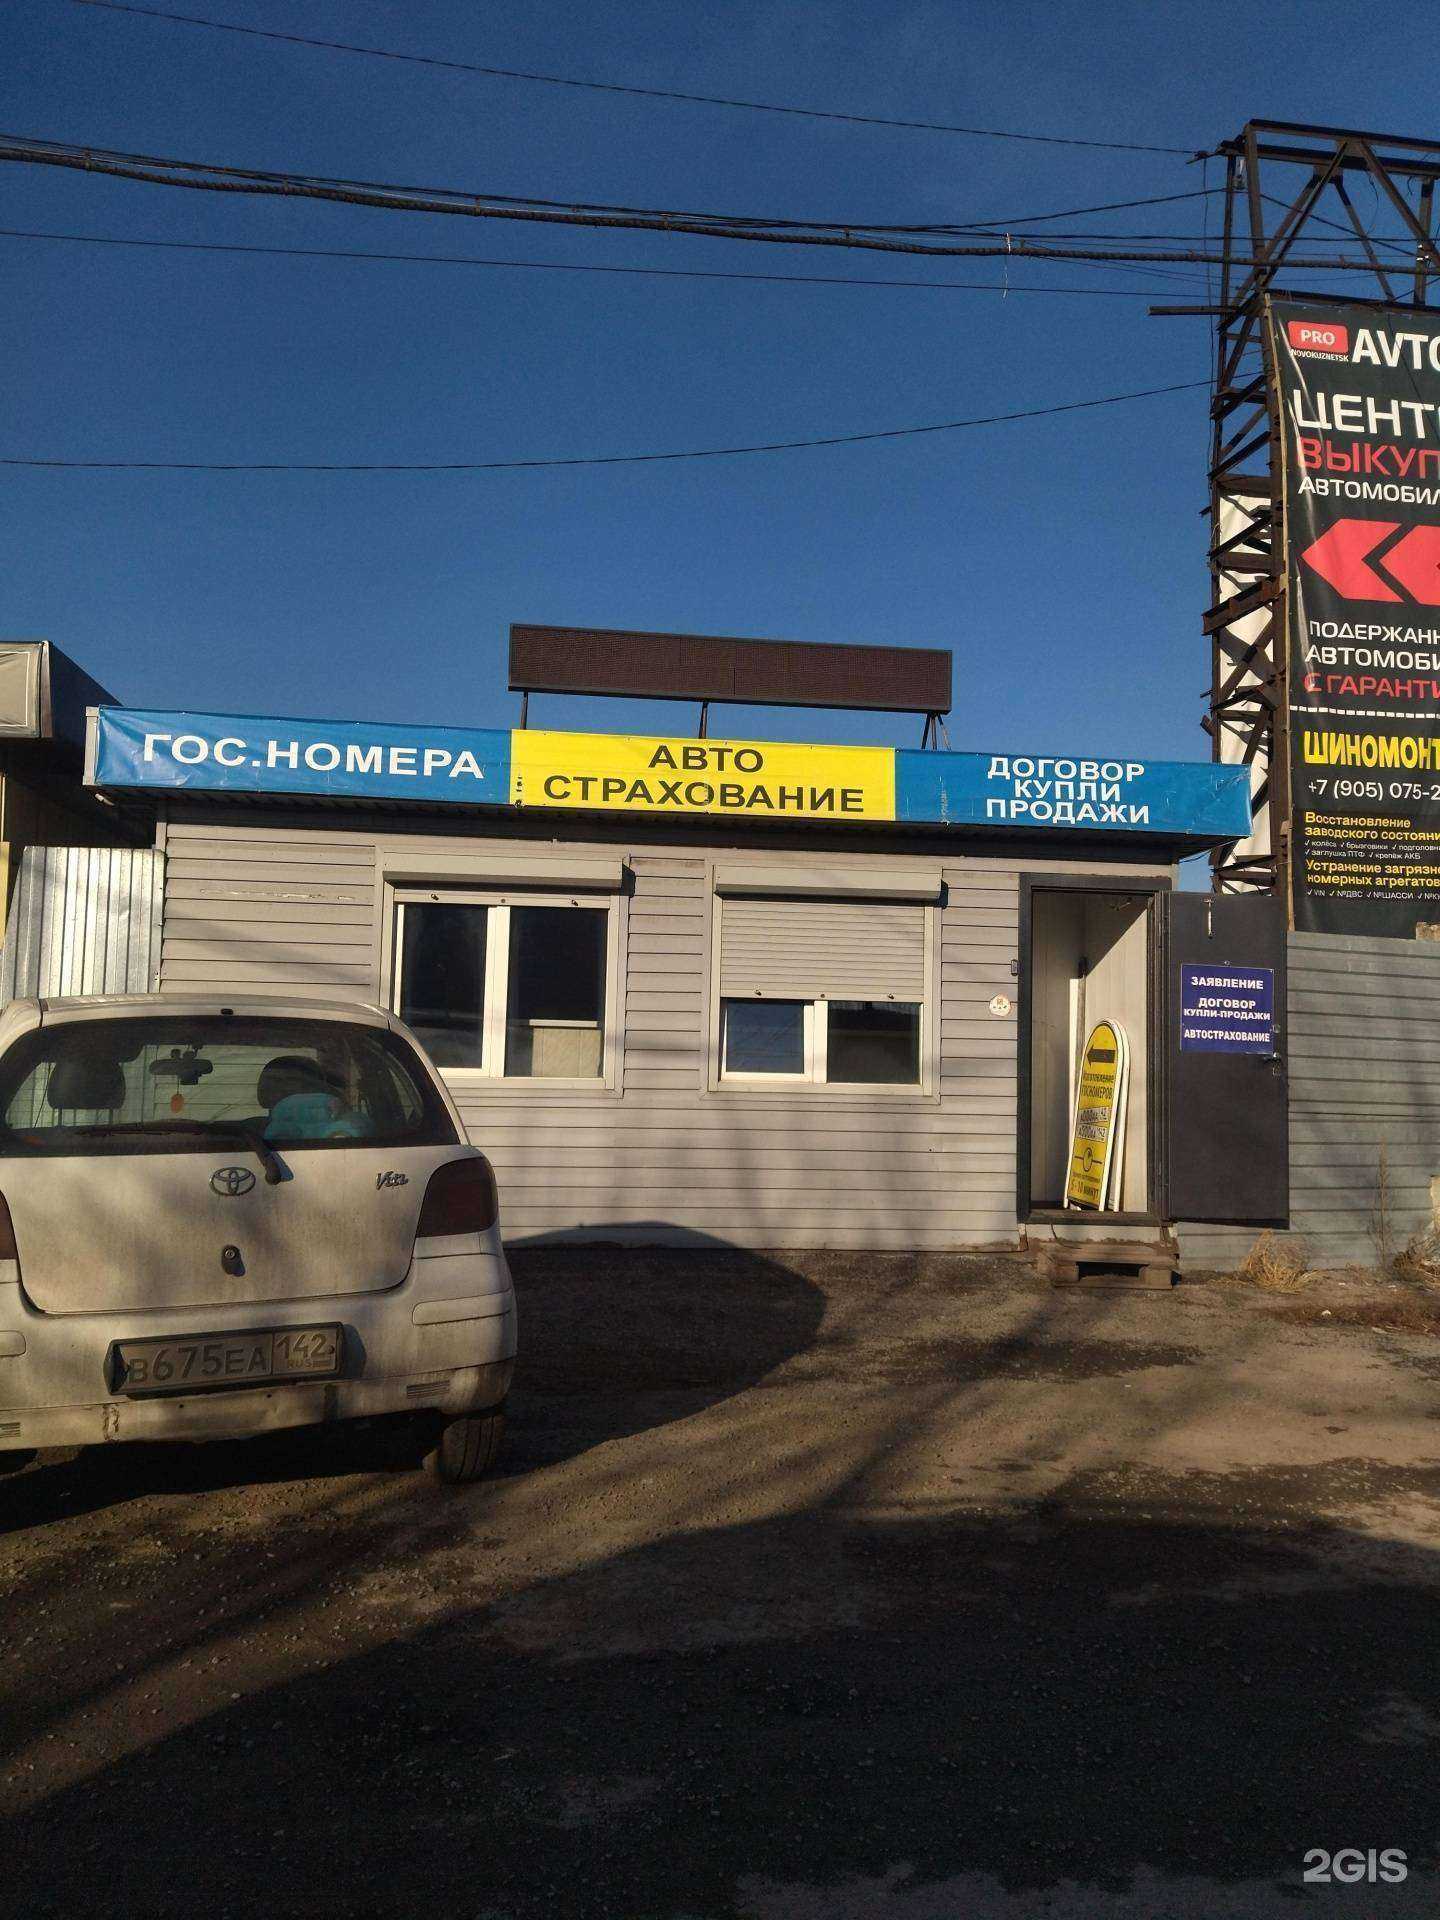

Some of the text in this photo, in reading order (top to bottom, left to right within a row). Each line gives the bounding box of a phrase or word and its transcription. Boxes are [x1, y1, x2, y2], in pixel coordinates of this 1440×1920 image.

[1300, 329, 1335, 346] PRO
[1291, 348, 1349, 362] NOVOKUZNETSK
[1293, 389, 1440, 439] ЦЕНТ
[1304, 672, 1322, 693] С
[143, 733, 485, 779] ГОС.НОМЕРА
[648, 745, 764, 773] АВТО
[987, 757, 1145, 782] ДОГОВОР
[543, 775, 865, 813] СТРАХОВАНИЕ
[1014, 779, 1121, 802] КУПЛИ
[1308, 779, 1328, 796] +7
[1334, 779, 1383, 801] (905)
[986, 798, 1150, 825] ПРОДАЖИ
[1305, 811, 1411, 828] Восстановление
[1304, 827, 1379, 839] заводского
[1305, 859, 1382, 874] Устранение
[1307, 873, 1440, 888] номерных агрегатов
[1191, 976, 1264, 990] ЗАЯВЛЕНИЕ
[1198, 997, 1256, 1010] ДОГОВОР
[1183, 1008, 1271, 1021] КУПЛИ-ПРОДАЖИ
[1184, 1028, 1270, 1042] АВТОСТРАХОВАНИЕ
[276, 1333, 328, 1360] 142
